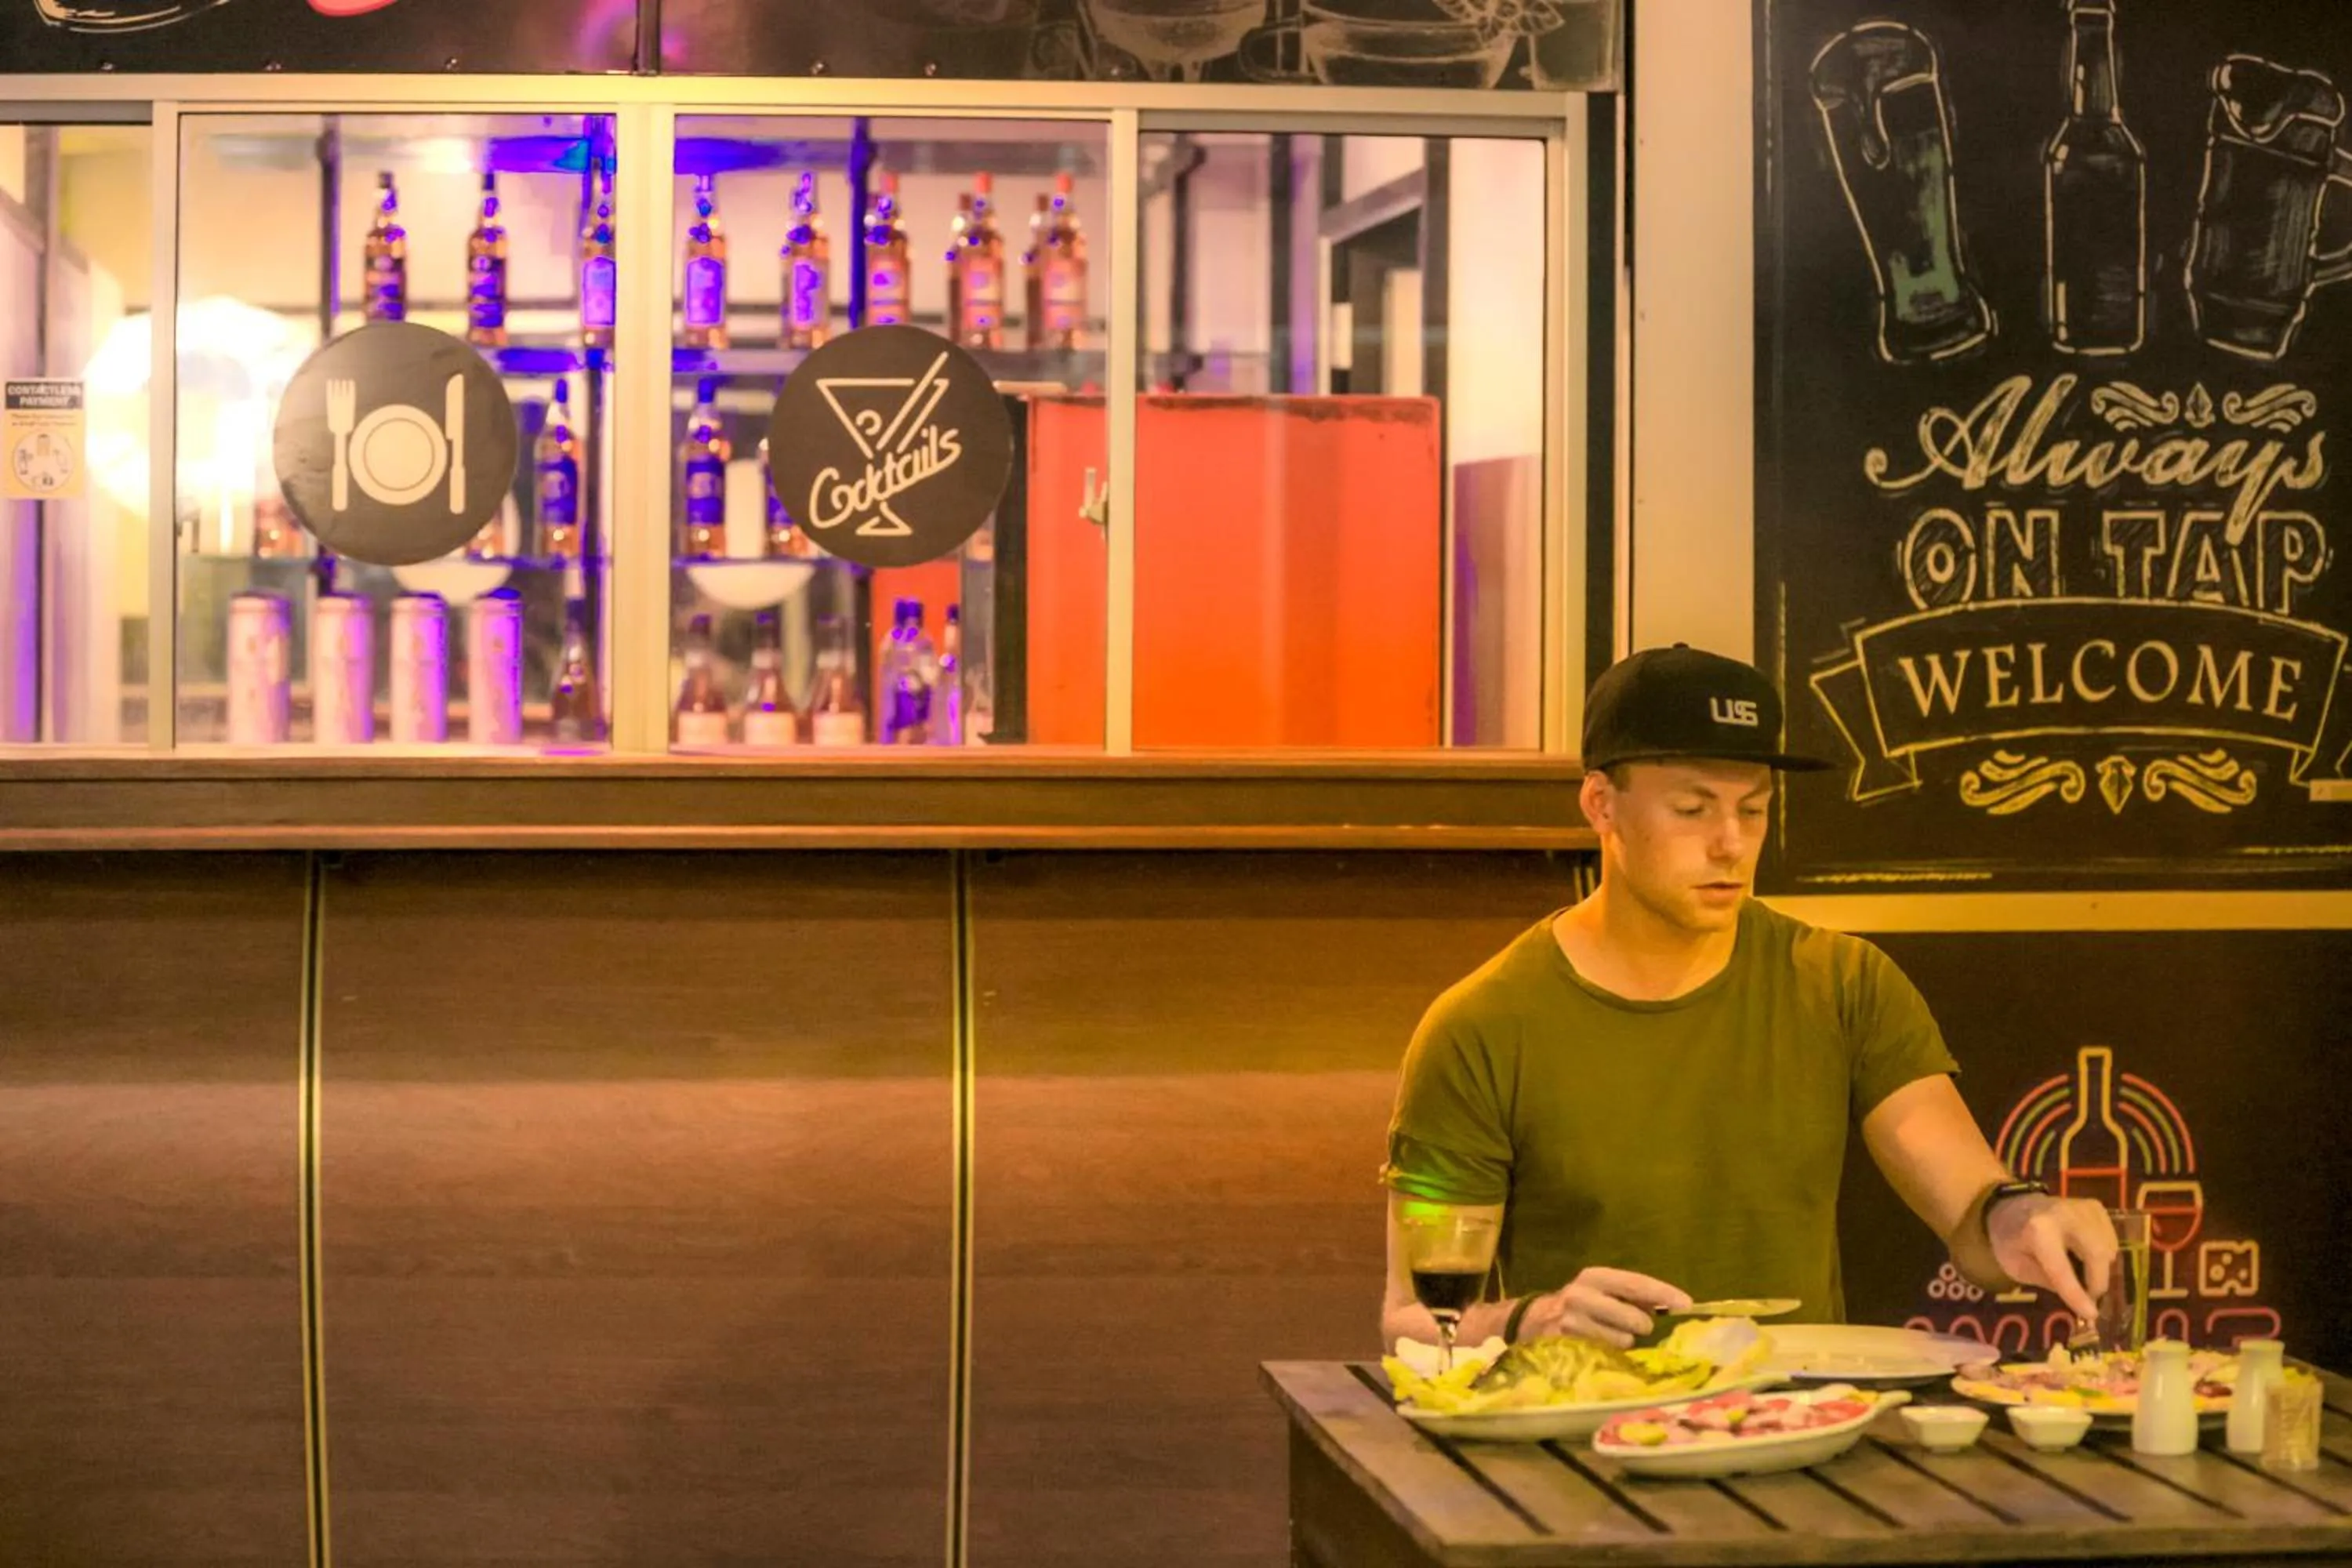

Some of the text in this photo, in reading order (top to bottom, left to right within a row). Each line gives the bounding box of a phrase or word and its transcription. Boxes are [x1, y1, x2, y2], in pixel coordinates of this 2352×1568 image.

[809, 424, 963, 529] Cocktails
[1864, 373, 2326, 546] Always
[1903, 507, 2326, 615] ON TAP
[1898, 639, 2302, 721] WELCOME
